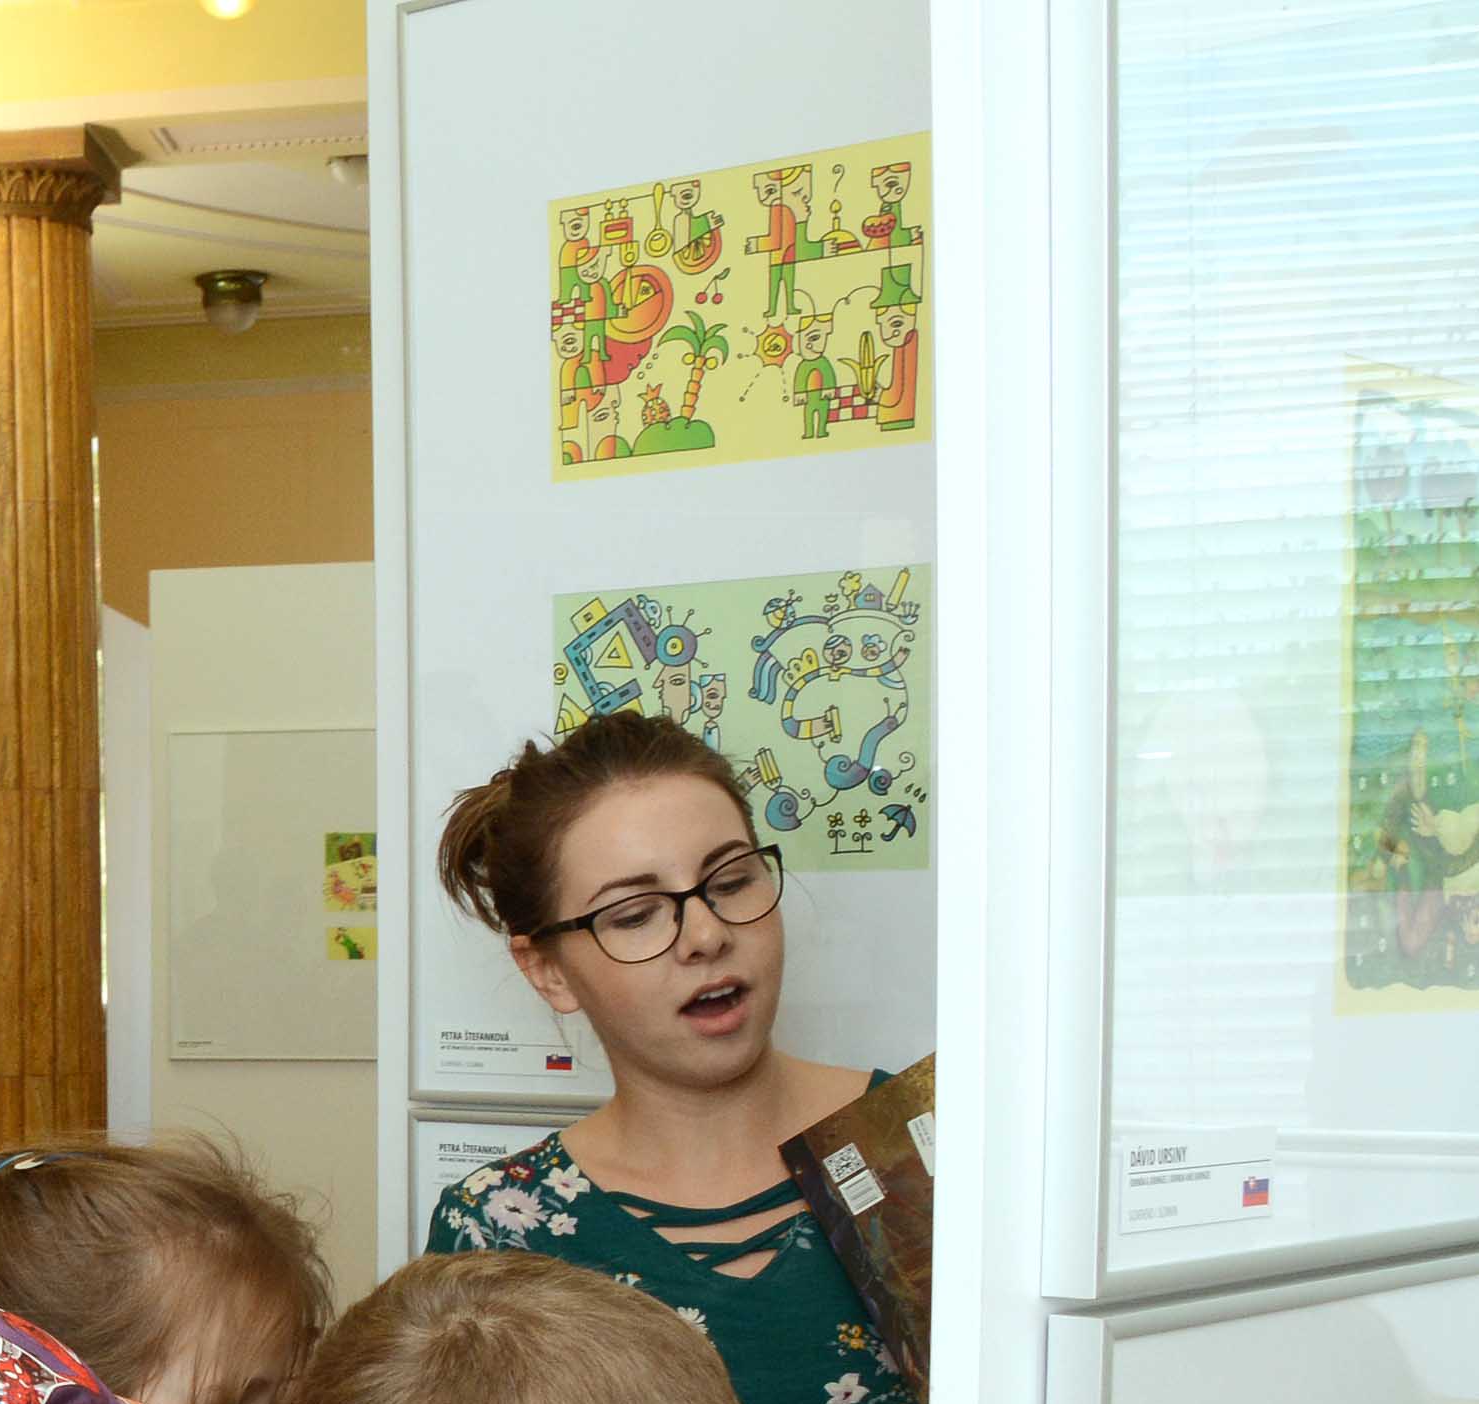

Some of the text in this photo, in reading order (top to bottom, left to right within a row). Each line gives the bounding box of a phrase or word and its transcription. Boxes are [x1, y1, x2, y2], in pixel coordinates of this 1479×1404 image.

[441, 1031, 462, 1041] PETRA
[439, 1143, 460, 1152] PETRA
[1130, 1146, 1155, 1168] DÁVID
